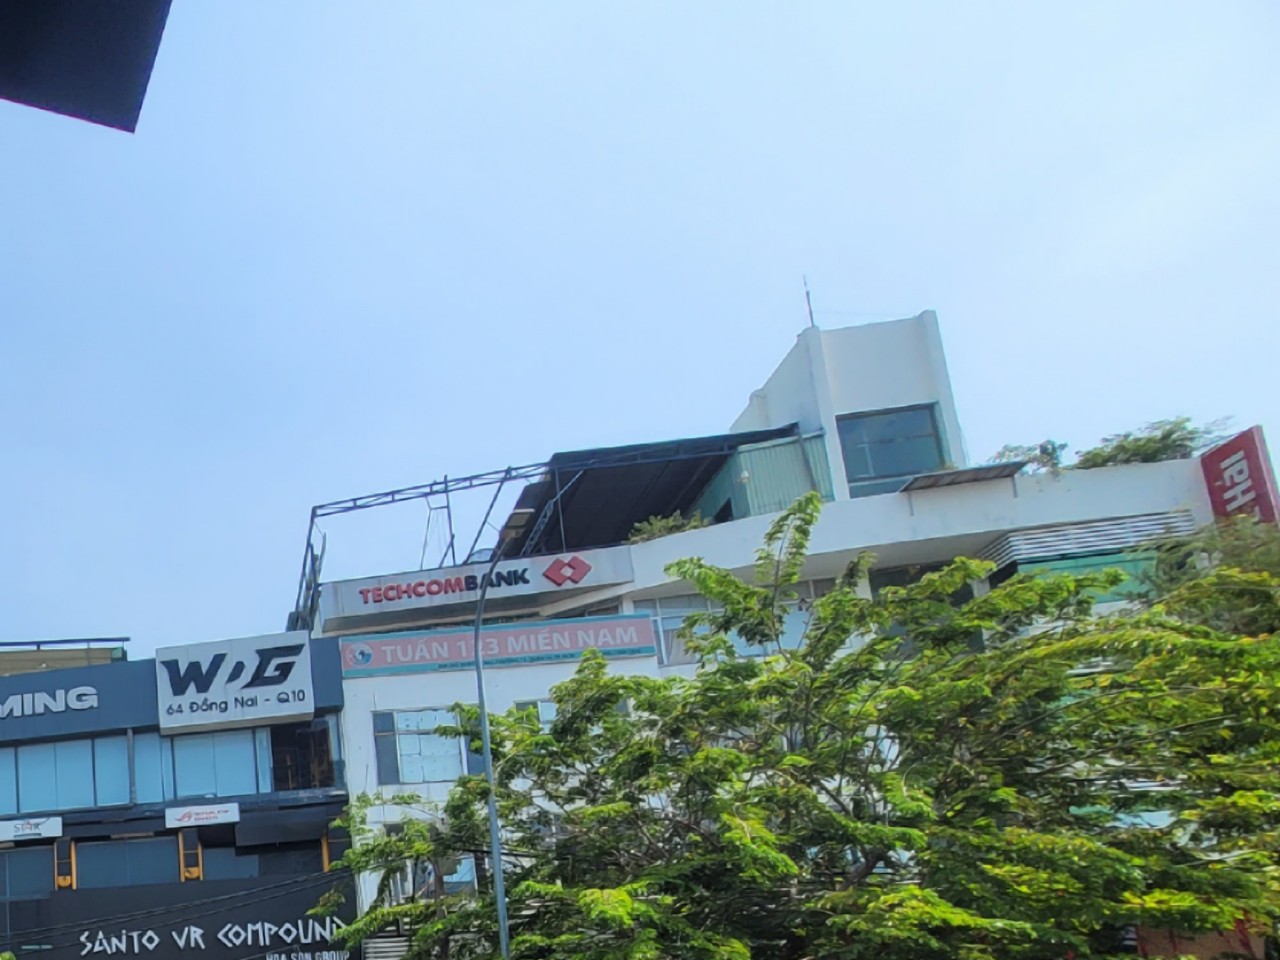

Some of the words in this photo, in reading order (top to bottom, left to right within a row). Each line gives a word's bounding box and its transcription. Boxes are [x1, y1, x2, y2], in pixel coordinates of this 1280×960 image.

[358, 567, 530, 604] TECHCOMBANK
[381, 637, 449, 663] TUẤN
[577, 626, 638, 648] NAM
[166, 704, 183, 715] 64
[234, 695, 258, 708] Nai
[276, 689, 306, 704] Q10
[79, 929, 161, 956] SANTO
[171, 925, 205, 949] VR
